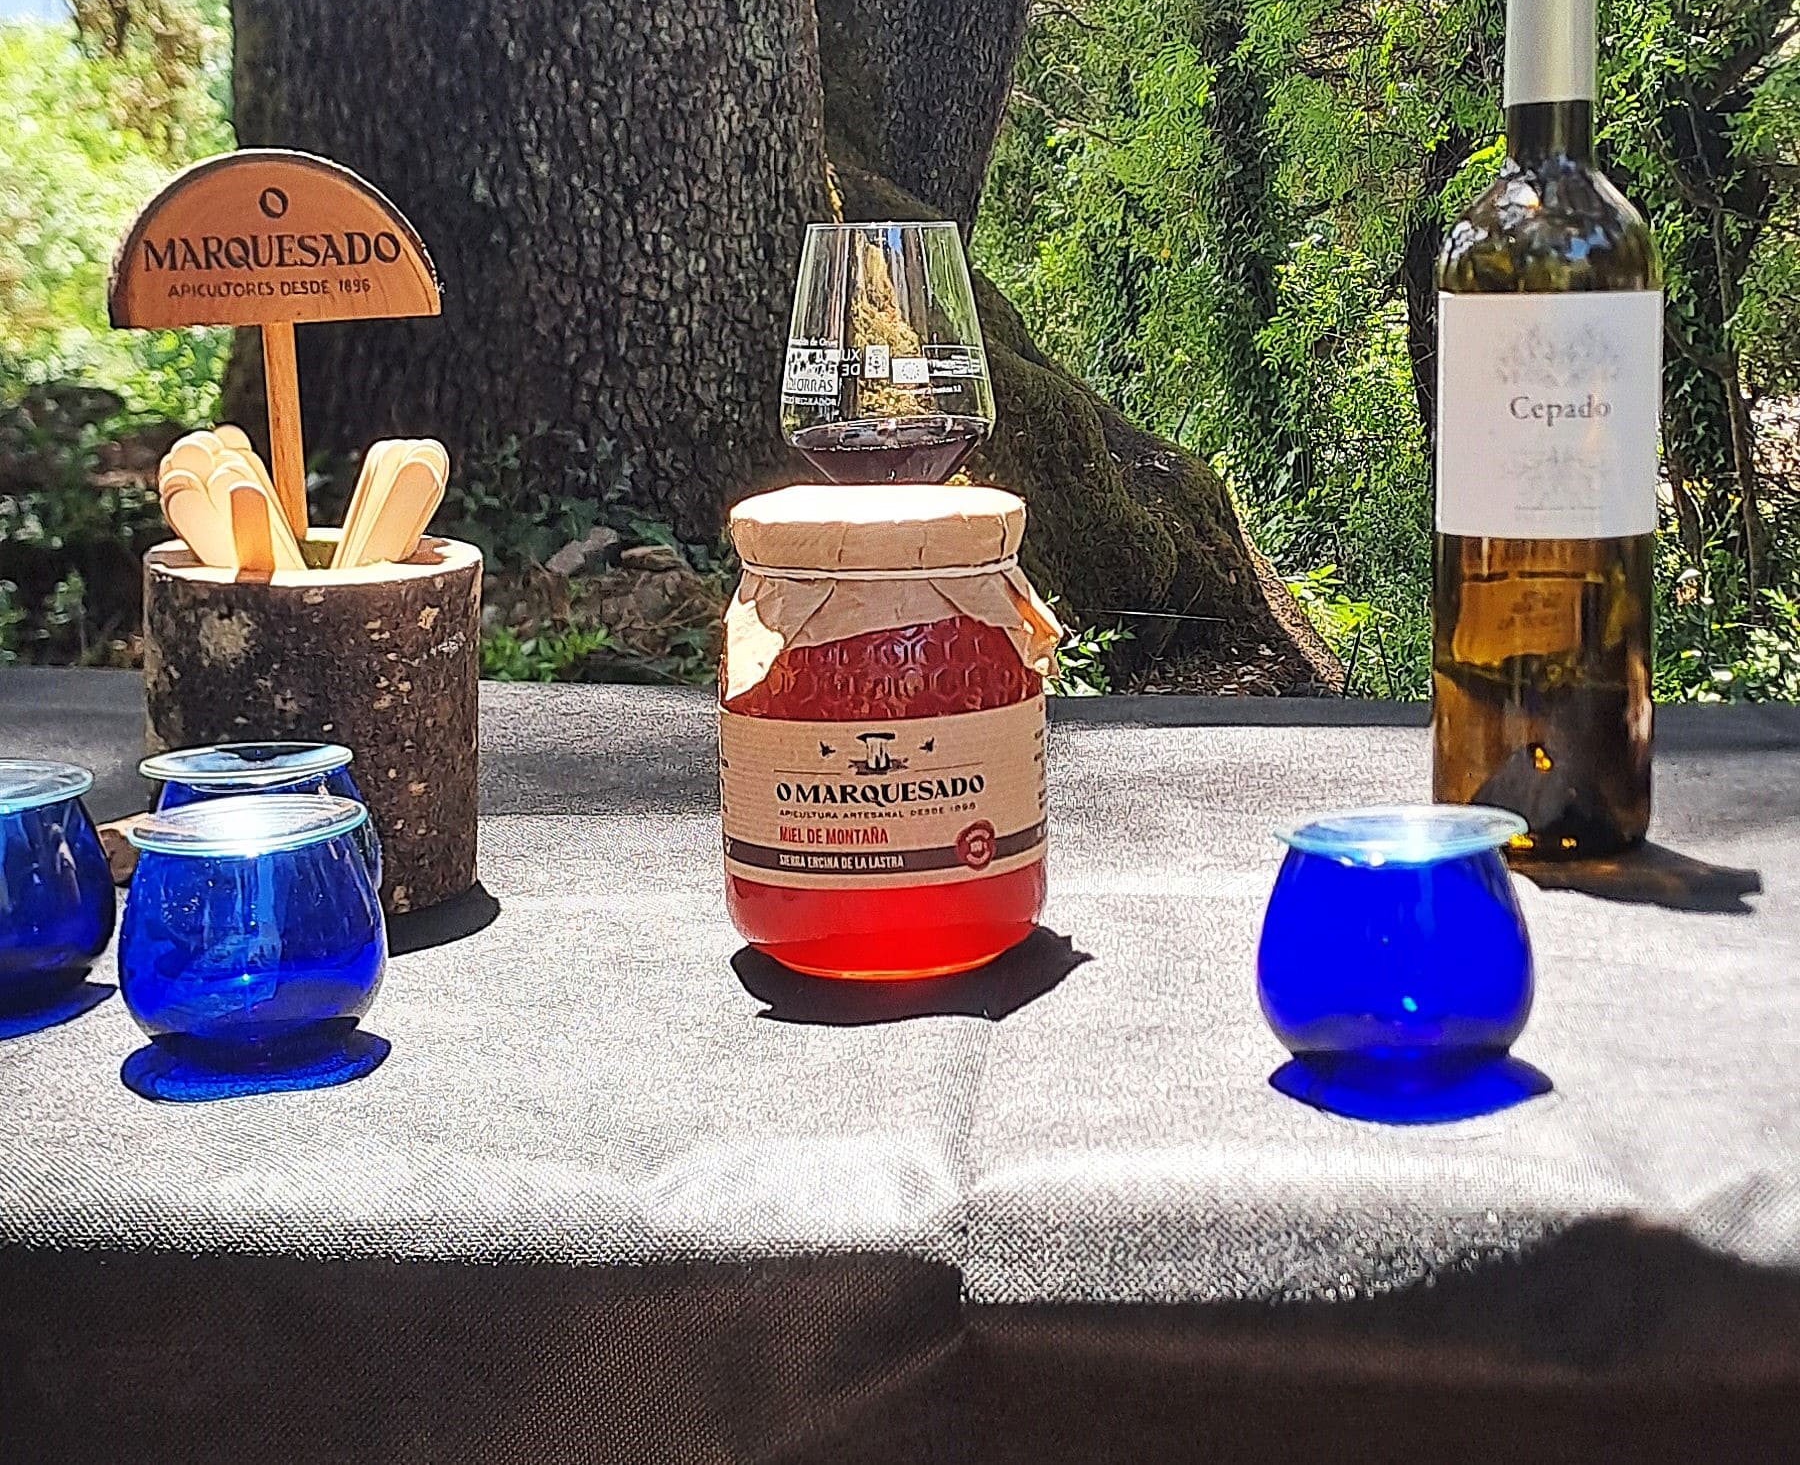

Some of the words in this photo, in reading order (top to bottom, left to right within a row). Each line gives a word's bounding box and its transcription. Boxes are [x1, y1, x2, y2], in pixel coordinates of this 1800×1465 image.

[259, 187, 289, 219] O
[144, 232, 402, 272] MARQUESADO
[168, 281, 275, 298] APICULTORES
[280, 279, 330, 296] DESDE
[1510, 394, 1612, 426] Cepado
[777, 782, 791, 802] O
[796, 775, 984, 807] MARQUESADO
[780, 809, 838, 819] APICULTURA
[843, 811, 904, 819] ARTESANAL
[911, 806, 944, 816] DESDE
[780, 826, 804, 843] MIEL
[807, 828, 823, 844] DE
[826, 826, 889, 845] MONTAÑA
[780, 854, 806, 867] SIERRA
[807, 856, 840, 870] ENCINA
[841, 856, 853, 870] DE
[855, 856, 867, 869] LA
[868, 855, 904, 869] LASTRA
